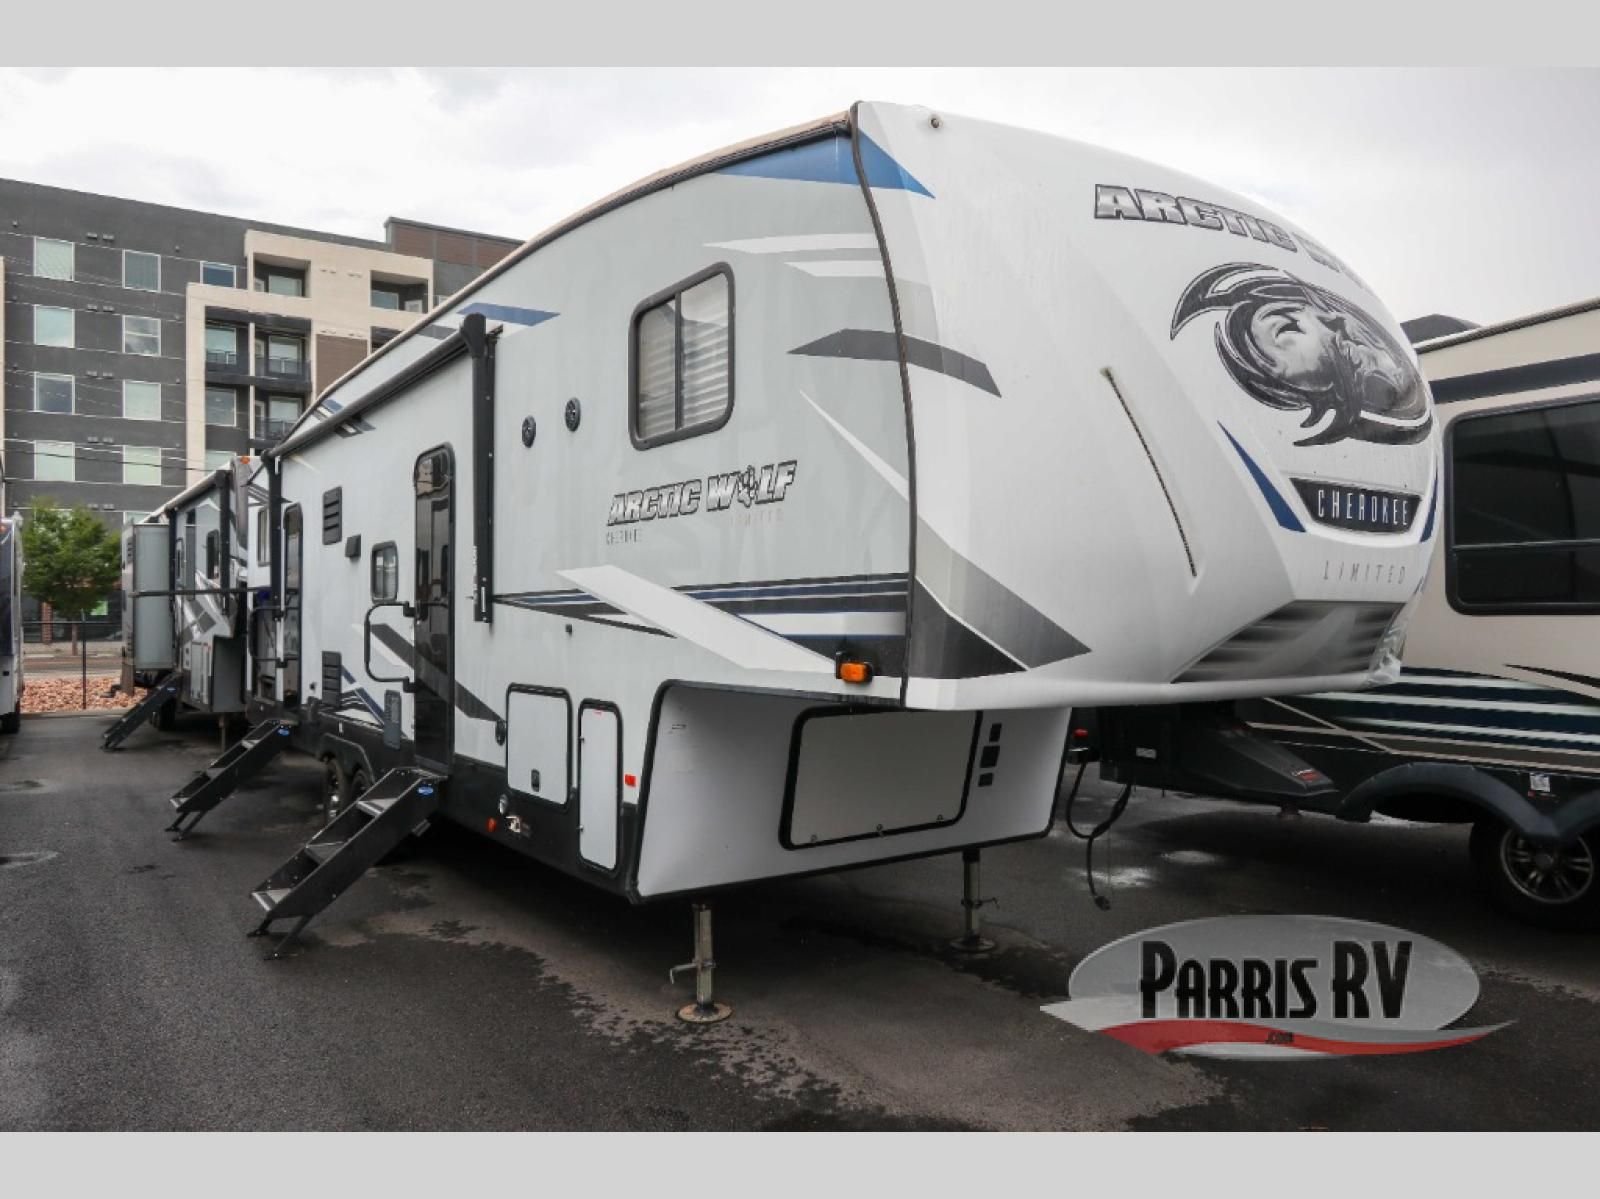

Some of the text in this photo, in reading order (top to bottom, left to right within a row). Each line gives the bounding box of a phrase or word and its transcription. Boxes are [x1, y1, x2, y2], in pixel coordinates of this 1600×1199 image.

[1094, 184, 1298, 253] ARCTIC
[607, 478, 702, 526] ARCTIC
[1317, 488, 1409, 527] CHEROKEE
[1322, 559, 1407, 585] LIMITED
